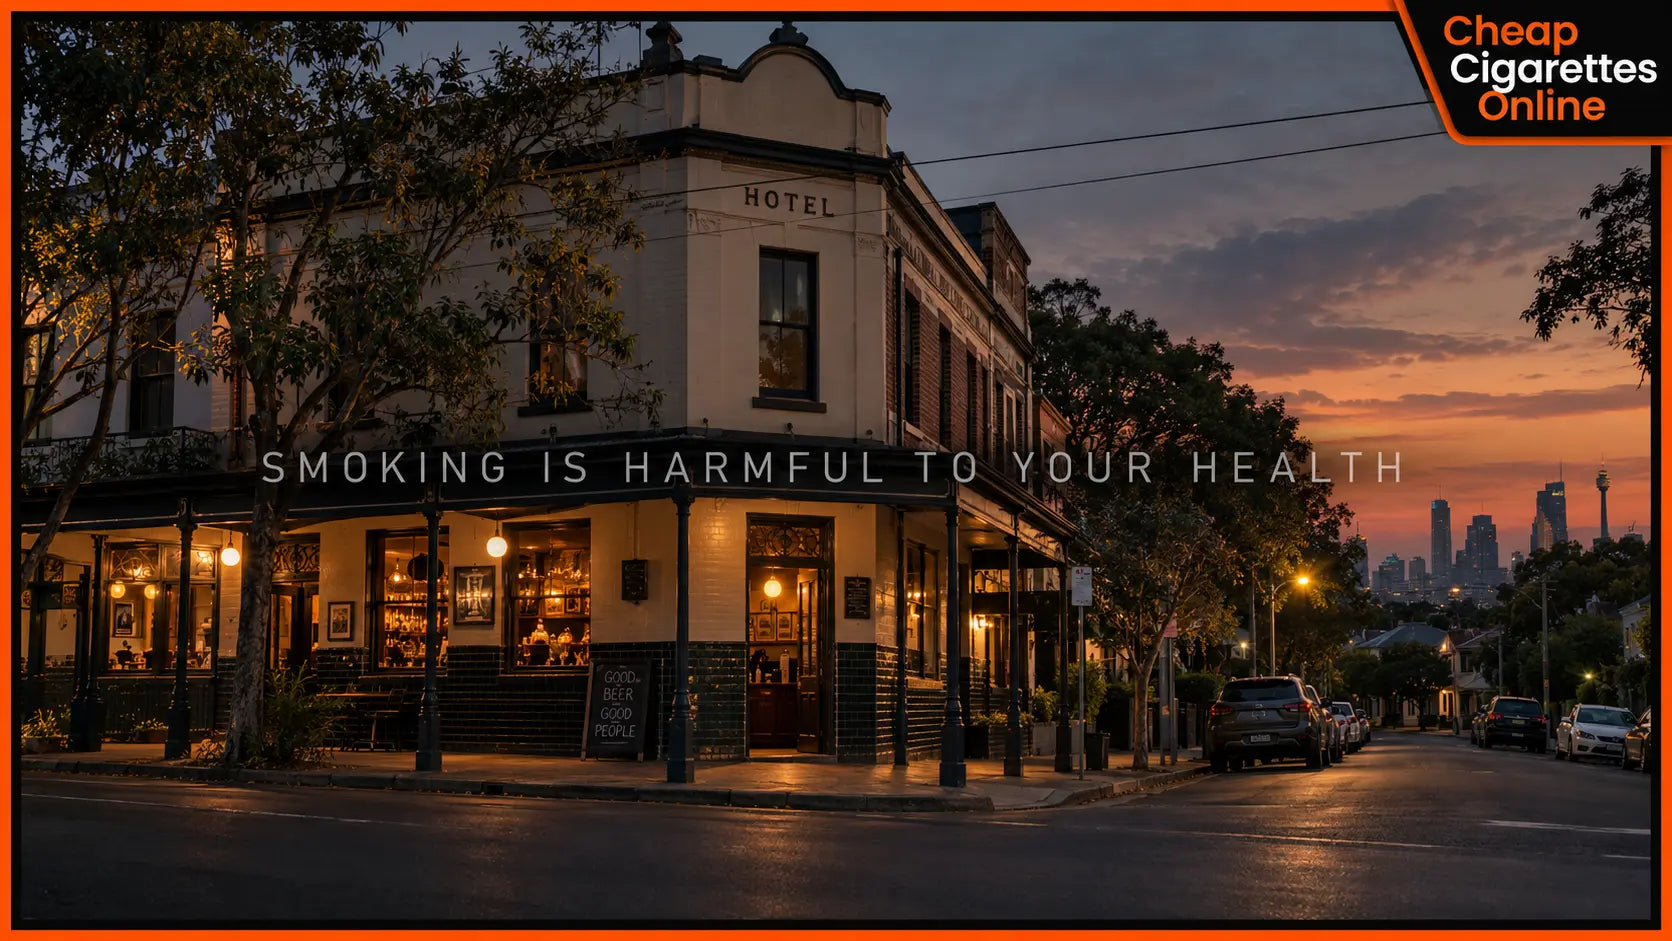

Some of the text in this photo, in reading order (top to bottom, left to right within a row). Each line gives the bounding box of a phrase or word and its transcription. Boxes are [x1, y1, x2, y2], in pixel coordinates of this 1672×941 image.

[744, 186, 835, 218] HOTEL
[604, 670, 636, 683] GOOD
[603, 687, 634, 701] BEER
[600, 706, 632, 720] GOOD
[594, 724, 637, 738] PEOPLE
